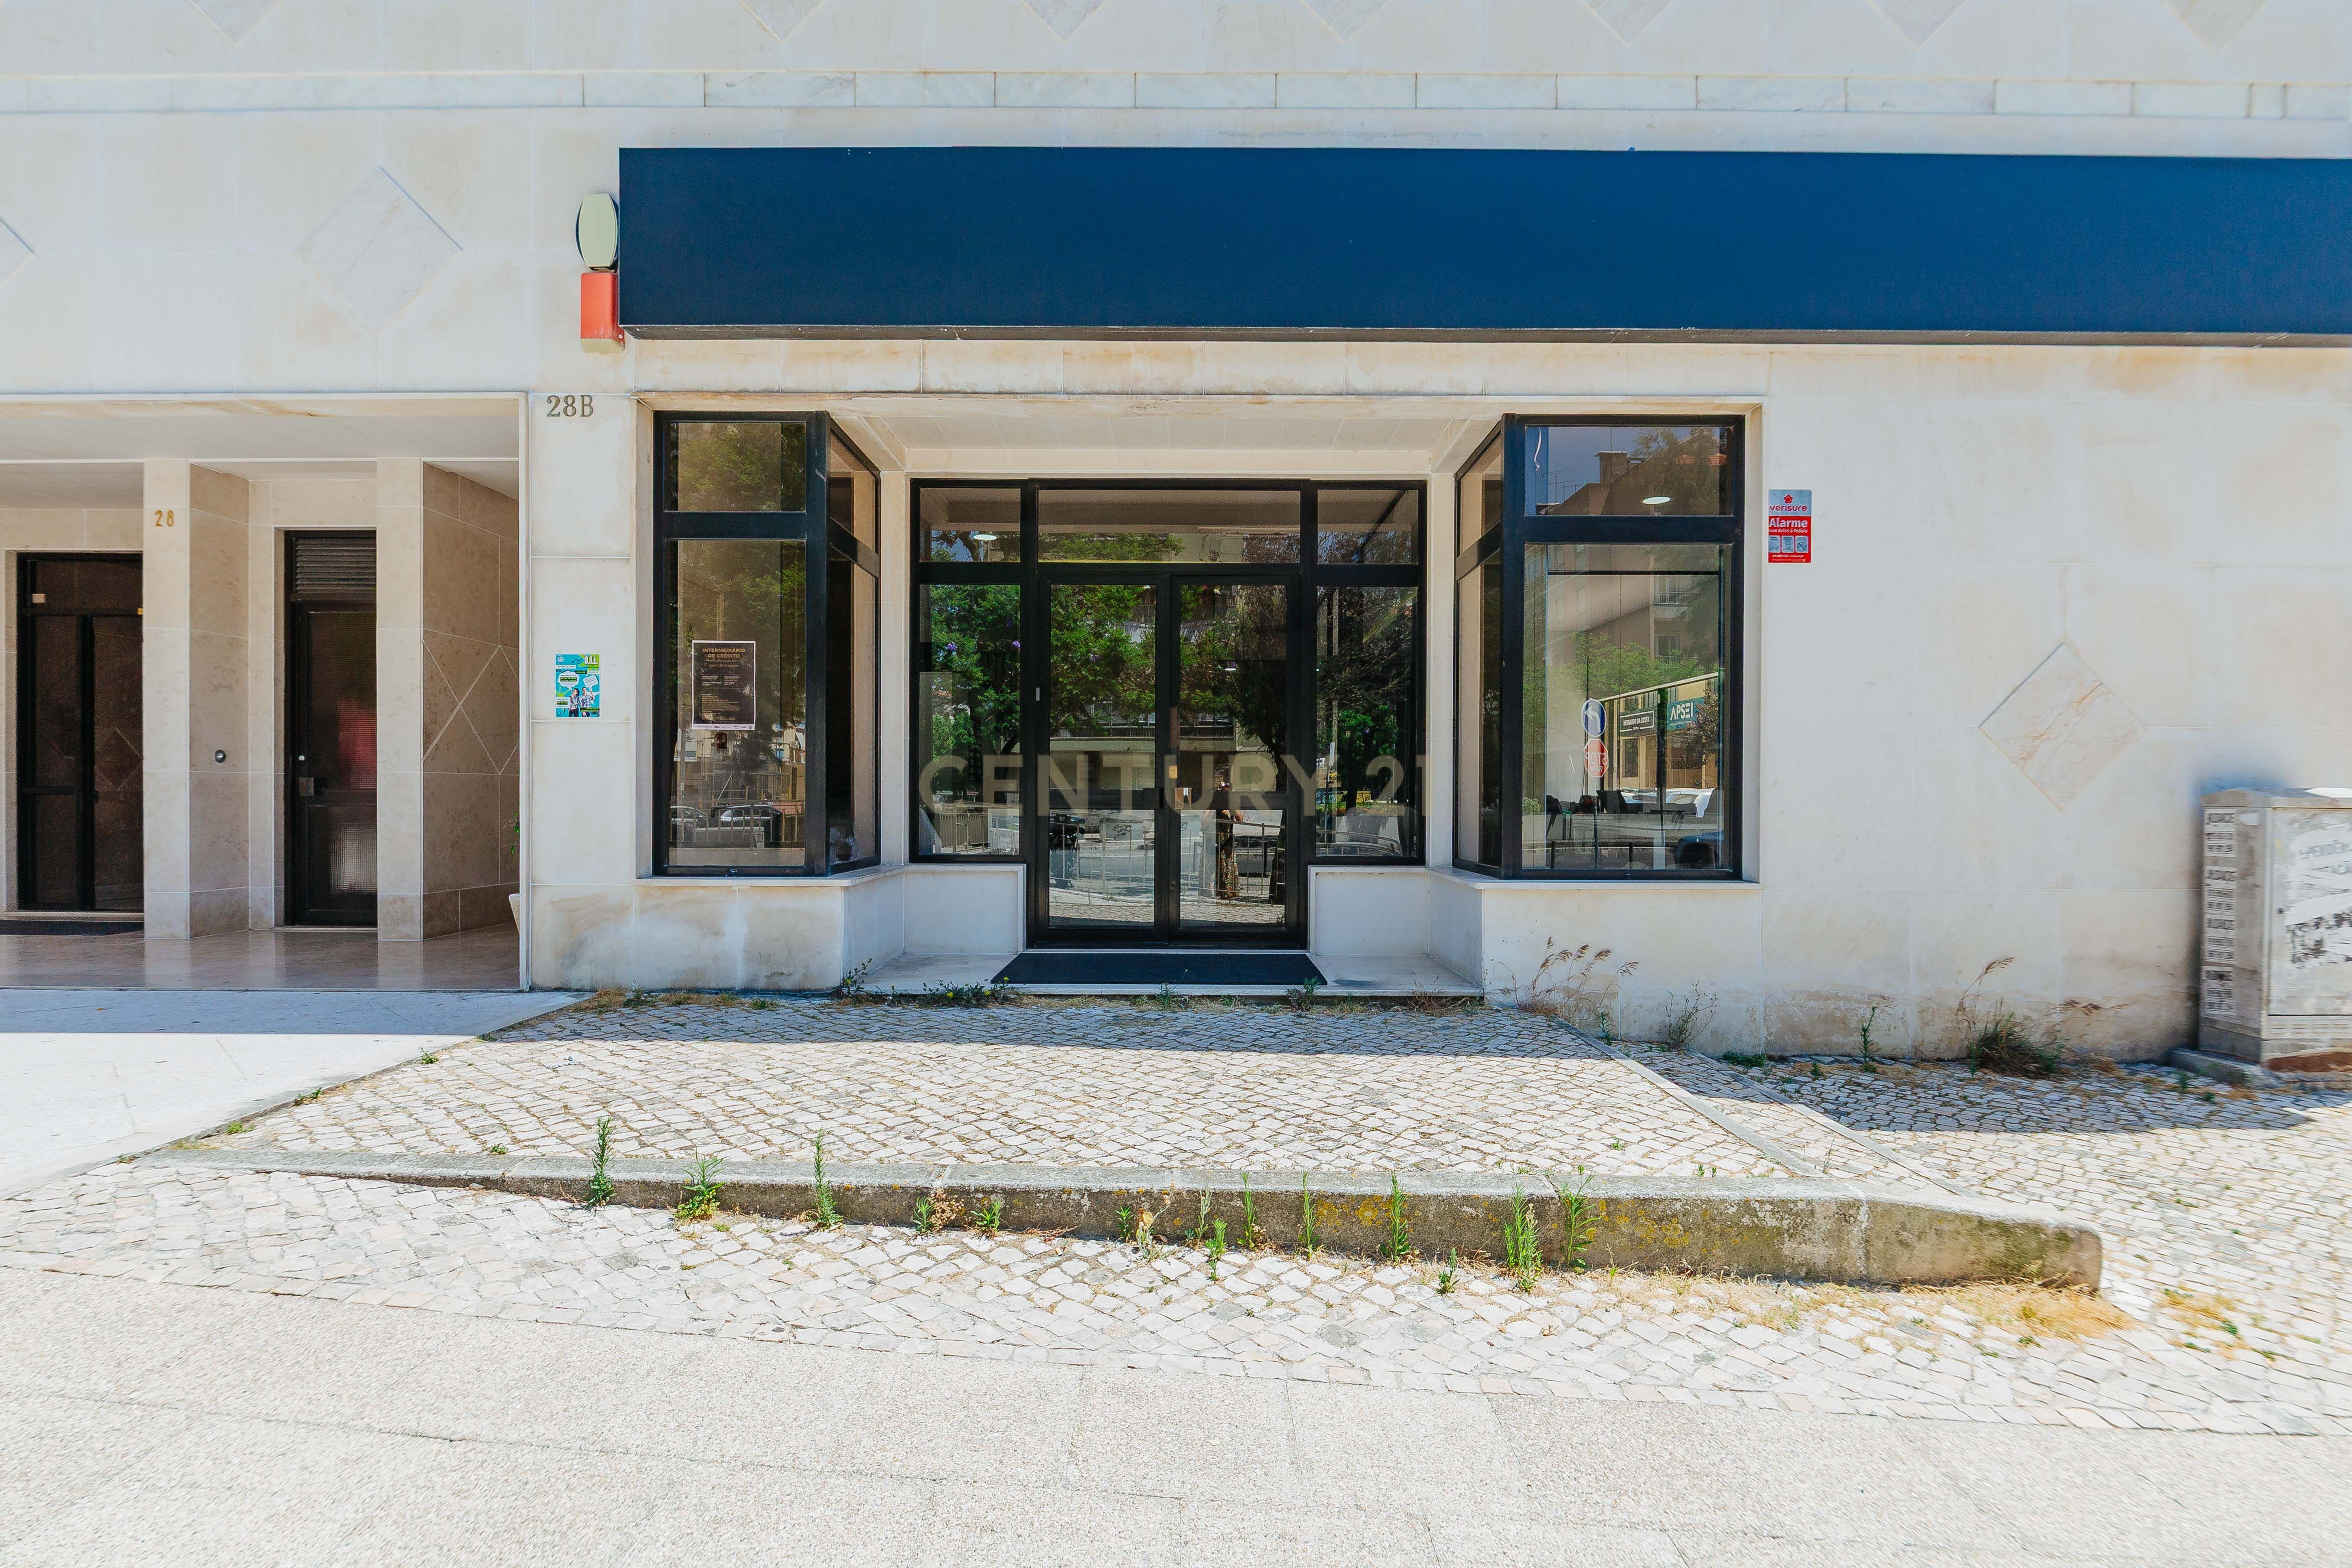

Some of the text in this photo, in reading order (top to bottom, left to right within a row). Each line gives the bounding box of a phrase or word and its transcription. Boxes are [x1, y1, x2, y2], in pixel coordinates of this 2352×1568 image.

[546, 394, 593, 417] 28B
[155, 510, 174, 527] 28
[1769, 517, 1808, 528] Alarme
[1670, 702, 1693, 720] APSEI
